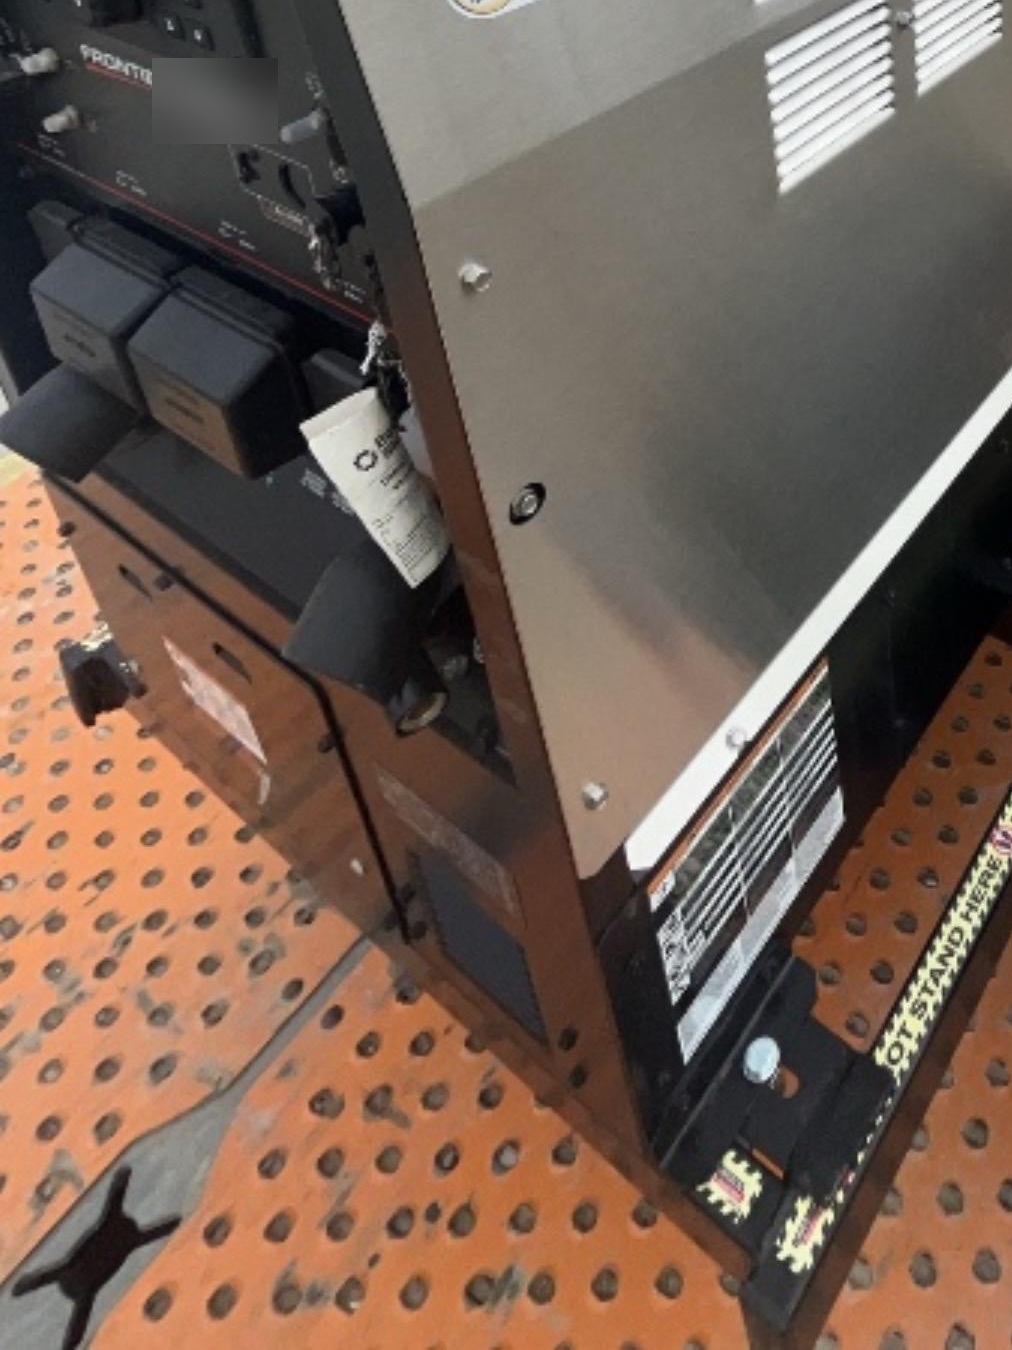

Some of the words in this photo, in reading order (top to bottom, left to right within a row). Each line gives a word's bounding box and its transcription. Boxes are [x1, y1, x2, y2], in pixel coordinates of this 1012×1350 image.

[886, 1021, 913, 1066] OT
[910, 925, 965, 1019] STAND
[960, 853, 1002, 923] HERE
